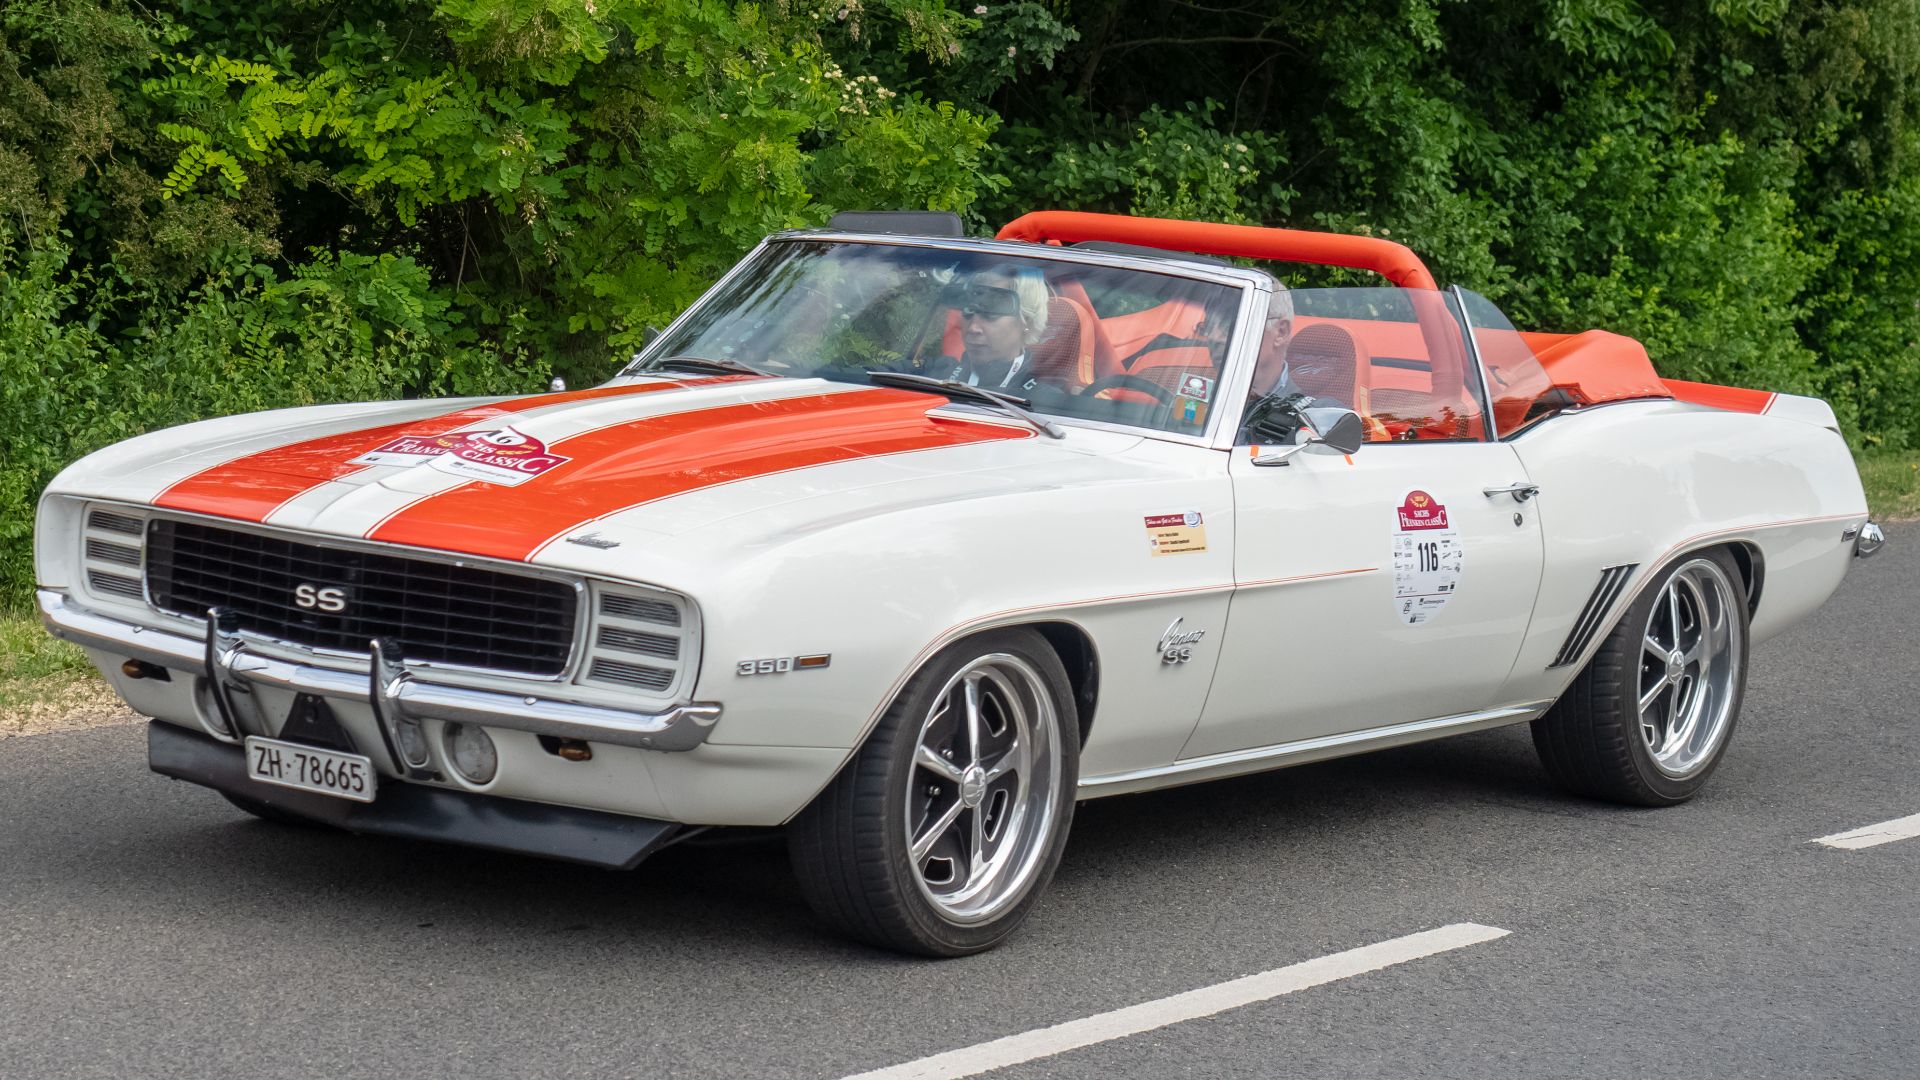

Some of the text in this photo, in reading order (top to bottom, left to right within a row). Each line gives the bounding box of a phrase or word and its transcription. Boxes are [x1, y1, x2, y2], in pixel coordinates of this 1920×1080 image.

[462, 450, 556, 472] CLASSIC
[1425, 510, 1446, 526] CLASSIC
[1418, 542, 1439, 572] 116
[295, 584, 346, 612] SS
[1157, 617, 1206, 652] Camaro
[738, 657, 792, 675] 350
[1165, 648, 1193, 665] SS
